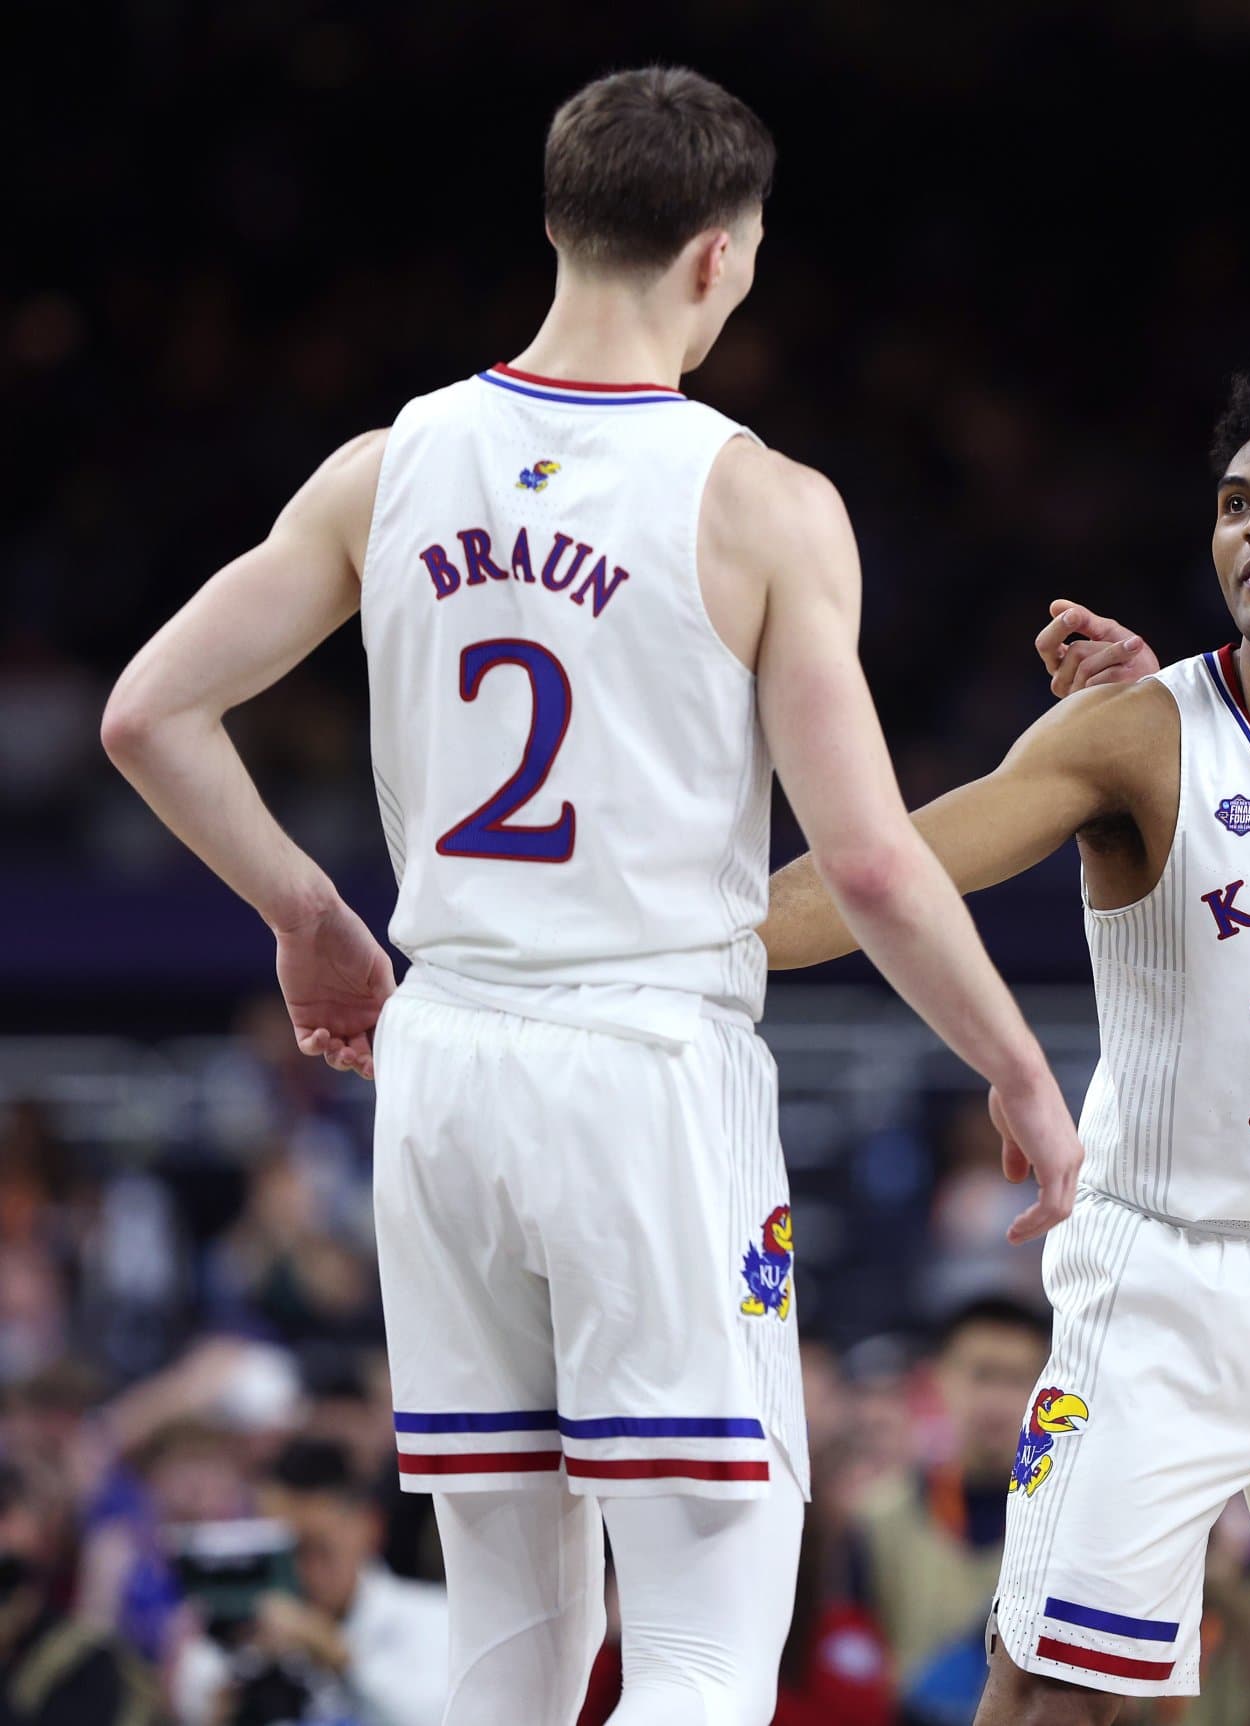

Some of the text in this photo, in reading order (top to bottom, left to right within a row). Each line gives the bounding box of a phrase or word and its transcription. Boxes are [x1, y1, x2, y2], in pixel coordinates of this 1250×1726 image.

[419, 527, 629, 619] BRAUN
[436, 638, 576, 863] 2
[760, 1264, 781, 1290] KU
